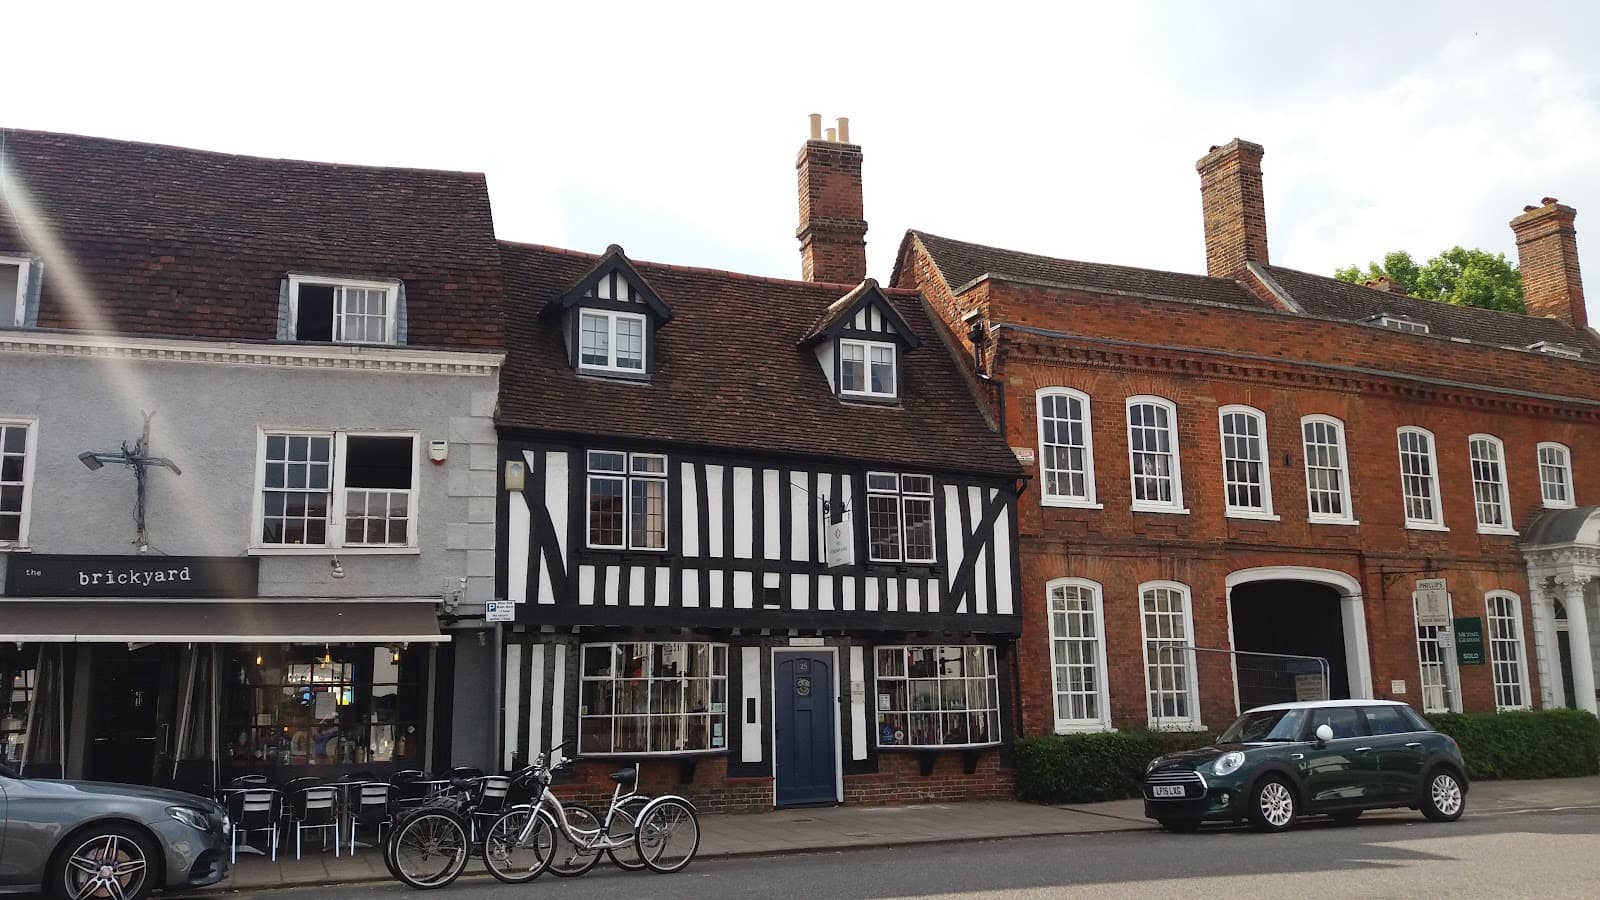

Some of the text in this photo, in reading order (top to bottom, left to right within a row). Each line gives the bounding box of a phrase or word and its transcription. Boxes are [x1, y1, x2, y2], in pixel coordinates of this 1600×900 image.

[79, 567, 192, 587] brickyard
[1419, 581, 1444, 589] PHILLIPS
[488, 604, 496, 612] P
[799, 662, 808, 670] 25
